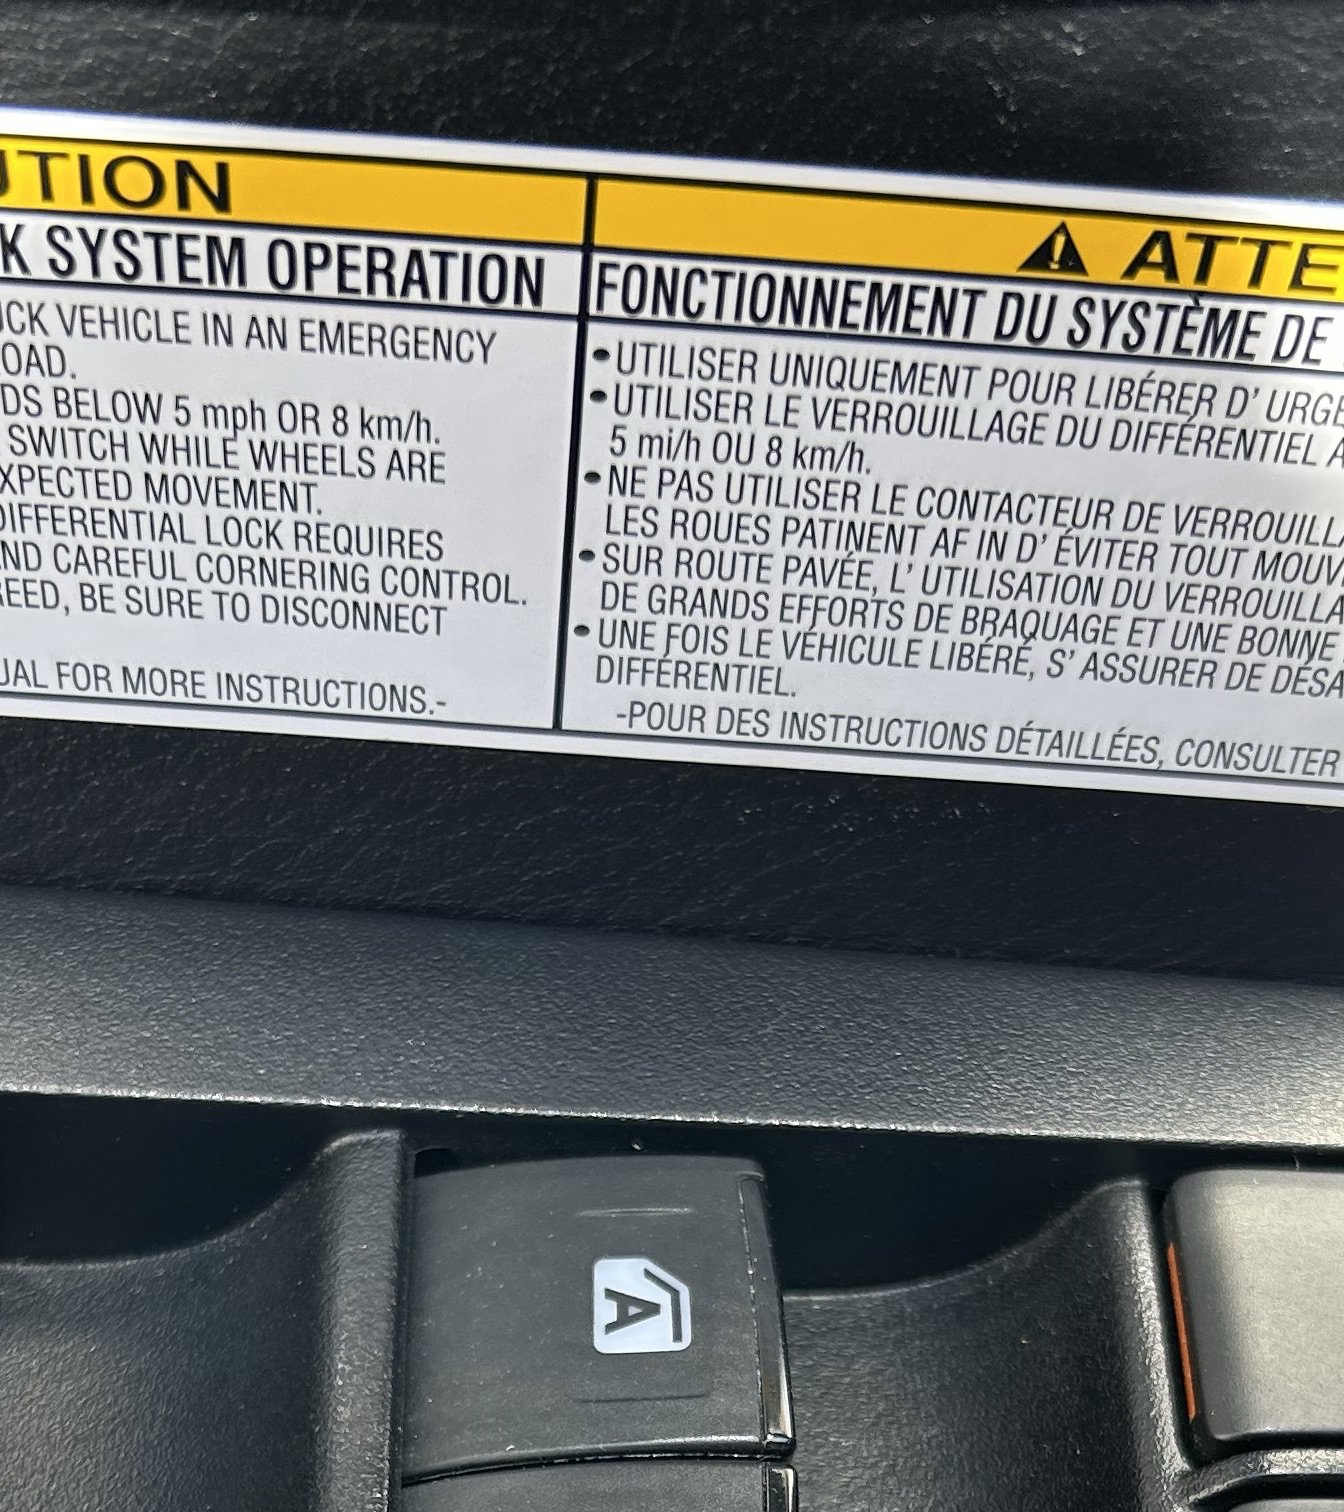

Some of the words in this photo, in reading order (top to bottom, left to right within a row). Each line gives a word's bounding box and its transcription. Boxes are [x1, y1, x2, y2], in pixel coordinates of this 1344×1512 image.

[45, 223, 247, 288] SYSTEM
[266, 237, 545, 308] OPERATION
[54, 302, 192, 345] VEHICLE
[202, 311, 234, 347] IN
[244, 314, 287, 351] AN
[298, 317, 497, 364] EMERGENCY
[595, 261, 988, 339] FONCTIONNEMENT
[992, 290, 1058, 346] DU
[1065, 294, 1267, 361] SYSTÈME
[1270, 313, 1333, 365] DE
[615, 339, 758, 384] UTILISER
[768, 350, 982, 399] UNIQUEMENT
[986, 366, 1076, 407] POUR
[1084, 367, 1218, 418] LIBÉRER
[52, 385, 163, 425] BELOW
[174, 394, 192, 427] 5
[201, 397, 266, 440] mph
[277, 399, 320, 436] OR
[331, 403, 349, 437] 8
[359, 406, 440, 444] km/h.
[613, 381, 753, 425] UTILISER
[763, 392, 801, 429] LE
[810, 395, 1050, 445] VERROUILLAGE
[1054, 413, 1103, 449] DU
[1108, 413, 1317, 466] DIFFÉRENTIEL
[6, 422, 130, 463] SWITCH
[137, 431, 239, 470] WHILE
[247, 437, 376, 479] WHEELS
[384, 446, 446, 484] ARE
[608, 423, 627, 457] 5
[637, 426, 701, 462] mi/h
[711, 430, 755, 466] OU
[764, 434, 783, 468] 8
[791, 435, 870, 474] km/h.
[143, 470, 322, 515] MOVEMENT.
[607, 463, 648, 498] NE
[656, 466, 714, 503] PAS
[724, 470, 862, 513] UTILISER
[870, 482, 908, 516] LE
[915, 485, 1115, 531] CONTACTEUR
[1121, 500, 1166, 534] DE
[204, 513, 283, 550] LOCK
[293, 519, 444, 562] REQUIRES
[605, 503, 659, 538] LES
[669, 507, 771, 546] ROUES
[780, 515, 922, 556] PATINENT
[1052, 526, 1159, 573] ÉVITER
[1169, 542, 1246, 579] TOUT
[52, 543, 187, 582] CAREFUL
[194, 552, 370, 595] CORNERING
[380, 563, 526, 606] CONTROL.
[601, 541, 663, 577] SUR
[673, 546, 773, 585] ROUTE
[781, 548, 878, 598] PAVÉE,
[920, 563, 1104, 607] UTILISATION
[1109, 576, 1156, 611] DU
[77, 581, 116, 614] BE
[123, 584, 204, 619] SURE
[215, 590, 250, 623] TO
[260, 592, 448, 636] DISCONNECT
[600, 579, 639, 614] DE
[646, 582, 770, 622] GRANDS
[778, 591, 905, 631] EFFORTS
[912, 600, 954, 634] DE
[959, 604, 1122, 646] BRAQUAGE
[1125, 615, 1166, 649] ET
[1169, 618, 1233, 654] UNE
[1235, 624, 1341, 662] BONNE
[55, 660, 113, 693] FOR
[121, 664, 207, 699] MORE
[594, 648, 796, 698] DIFFÉRENTIEL.
[597, 617, 657, 652] UNE
[664, 621, 729, 656] FOIS
[737, 626, 773, 660] LE
[781, 621, 923, 668] VÉHICULE
[928, 634, 1035, 684] LIBÉRÉ,
[1077, 650, 1218, 689] ASSURER
[1223, 660, 1267, 693] DE
[715, 705, 770, 738] DES
[778, 709, 988, 752] INSTRUCTIONS
[994, 718, 1164, 771] DÉTAILLÉES,
[1174, 737, 1341, 777] CONSULTER
[604, 1286, 661, 1336] A
